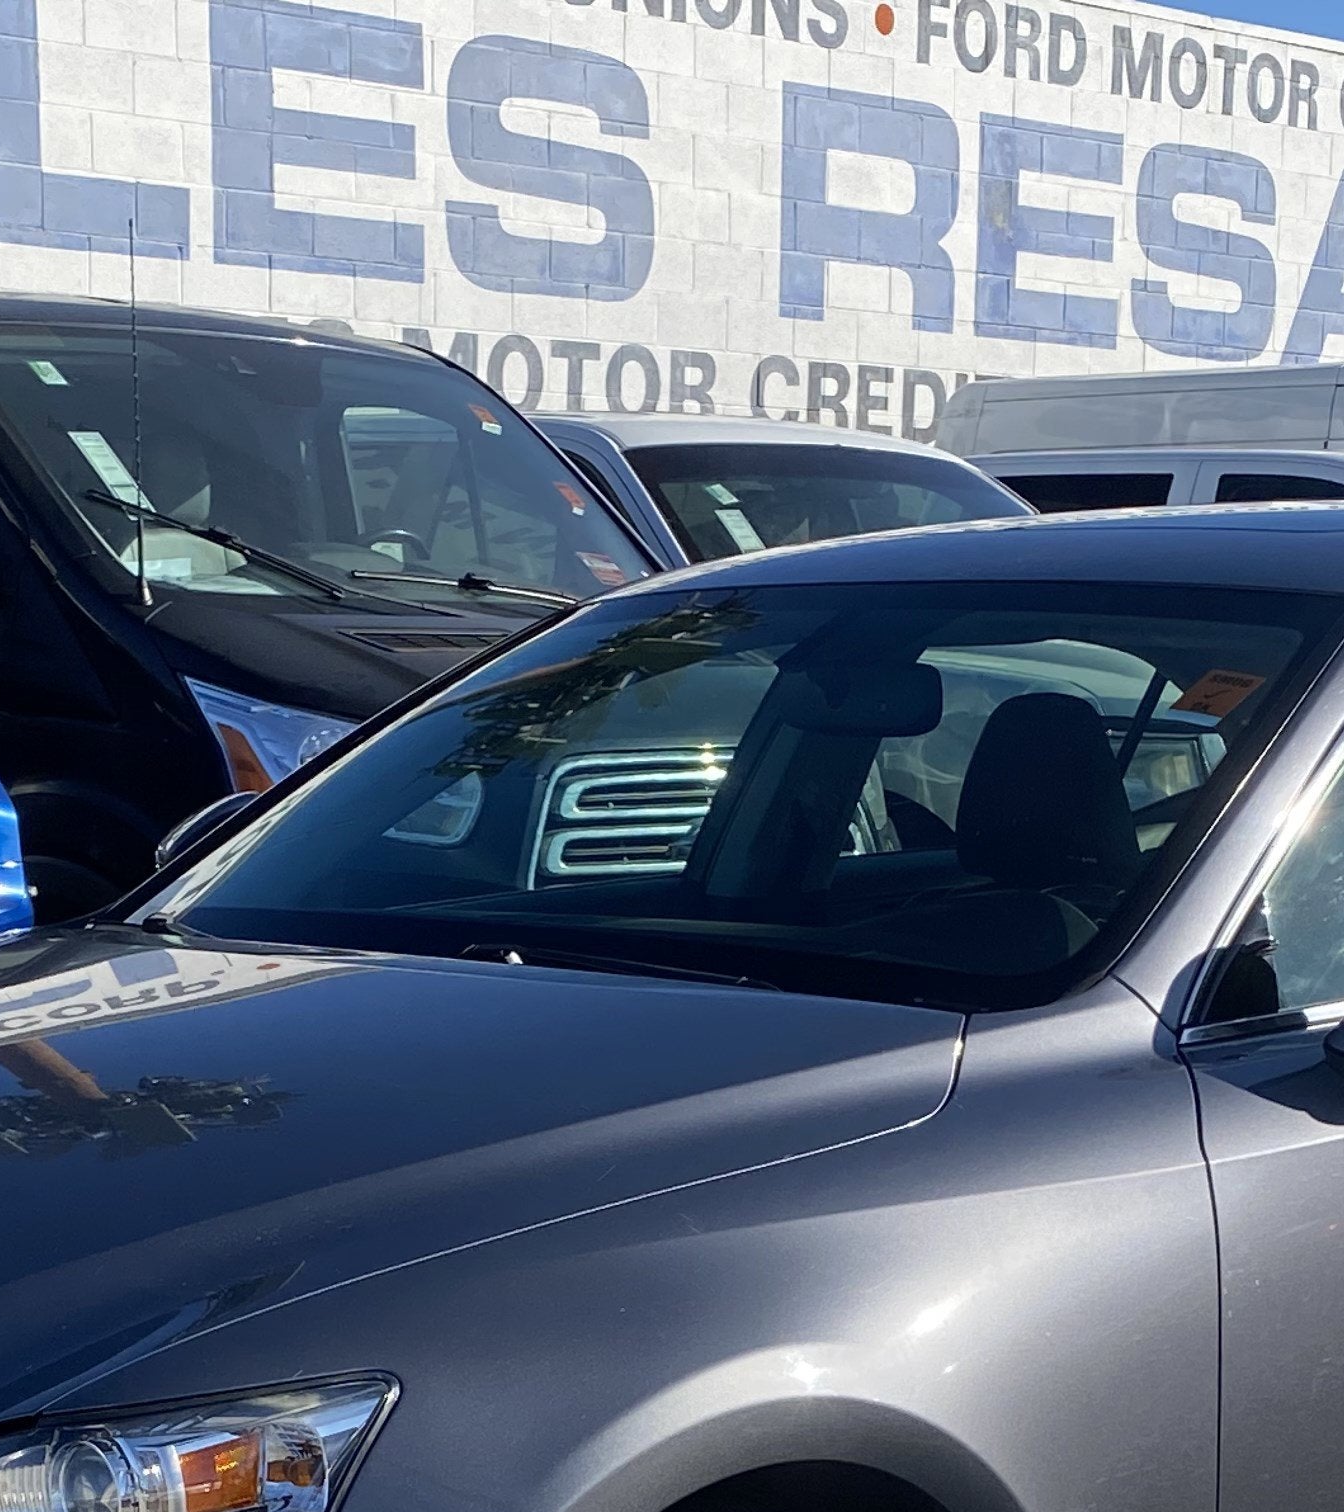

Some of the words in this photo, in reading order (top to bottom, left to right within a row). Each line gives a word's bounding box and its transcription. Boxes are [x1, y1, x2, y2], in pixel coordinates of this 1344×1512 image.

[916, 0, 1087, 87] FORD
[1110, 24, 1320, 131] MOTOR
[750, 354, 1010, 446] CRED
